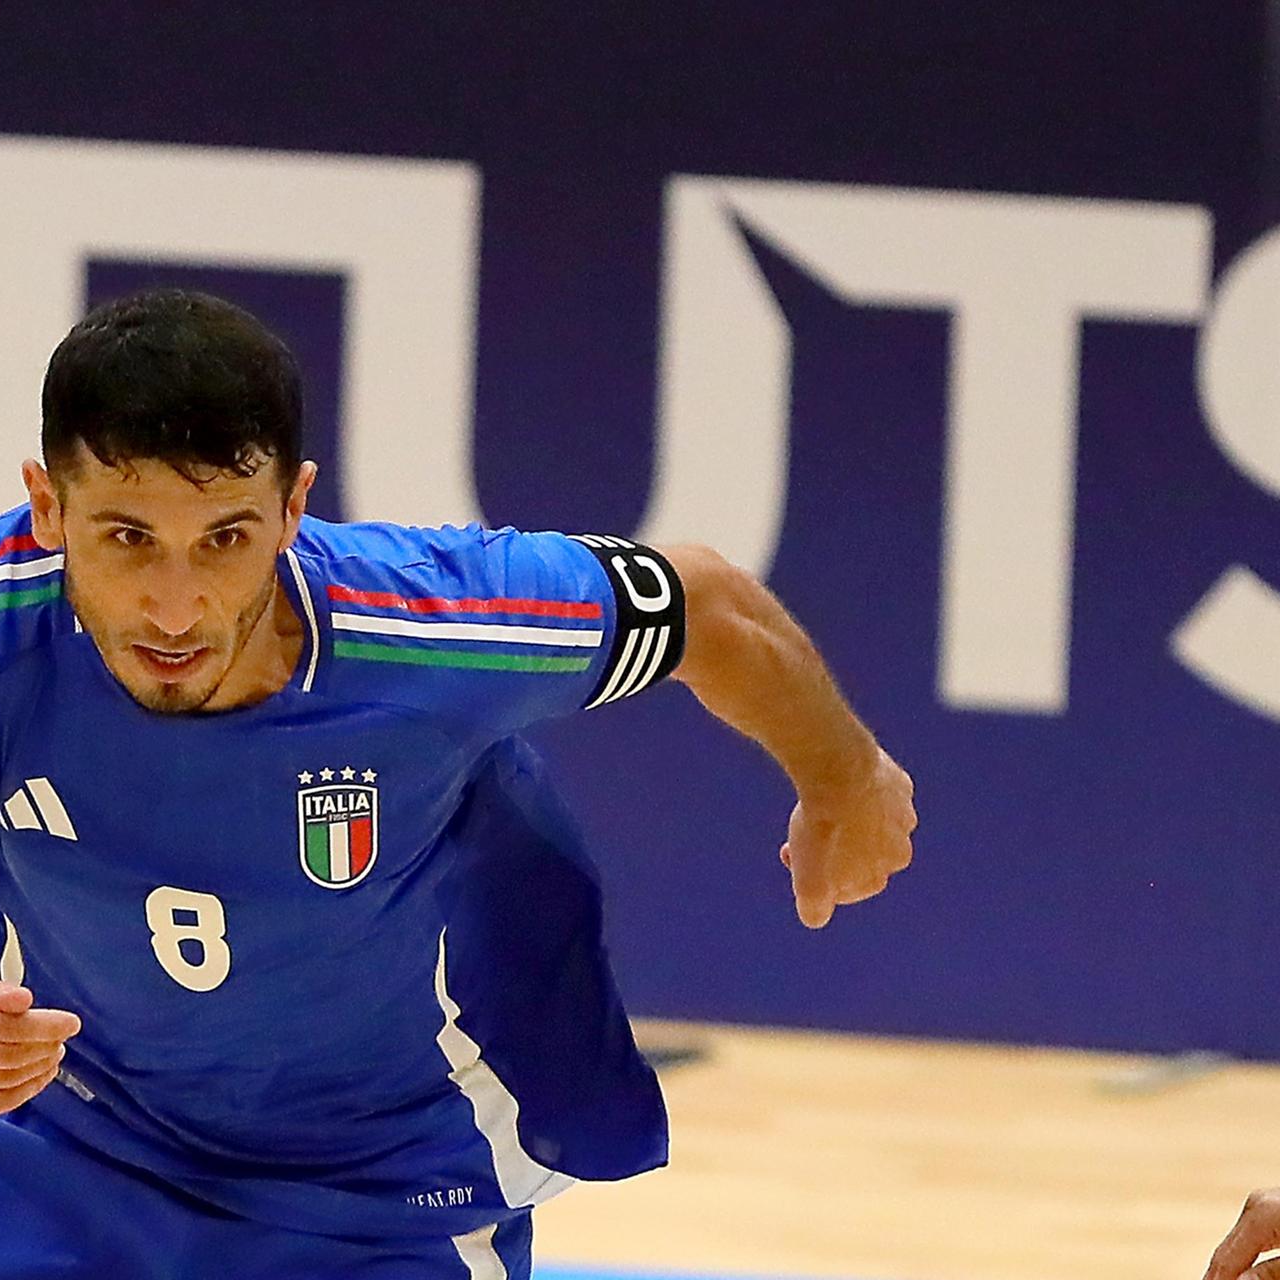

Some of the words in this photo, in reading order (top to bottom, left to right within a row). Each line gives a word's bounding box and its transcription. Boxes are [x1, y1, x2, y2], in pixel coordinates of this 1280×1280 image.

[610, 554, 672, 613] C
[305, 792, 371, 816] ITALIA
[145, 885, 231, 992] 8
